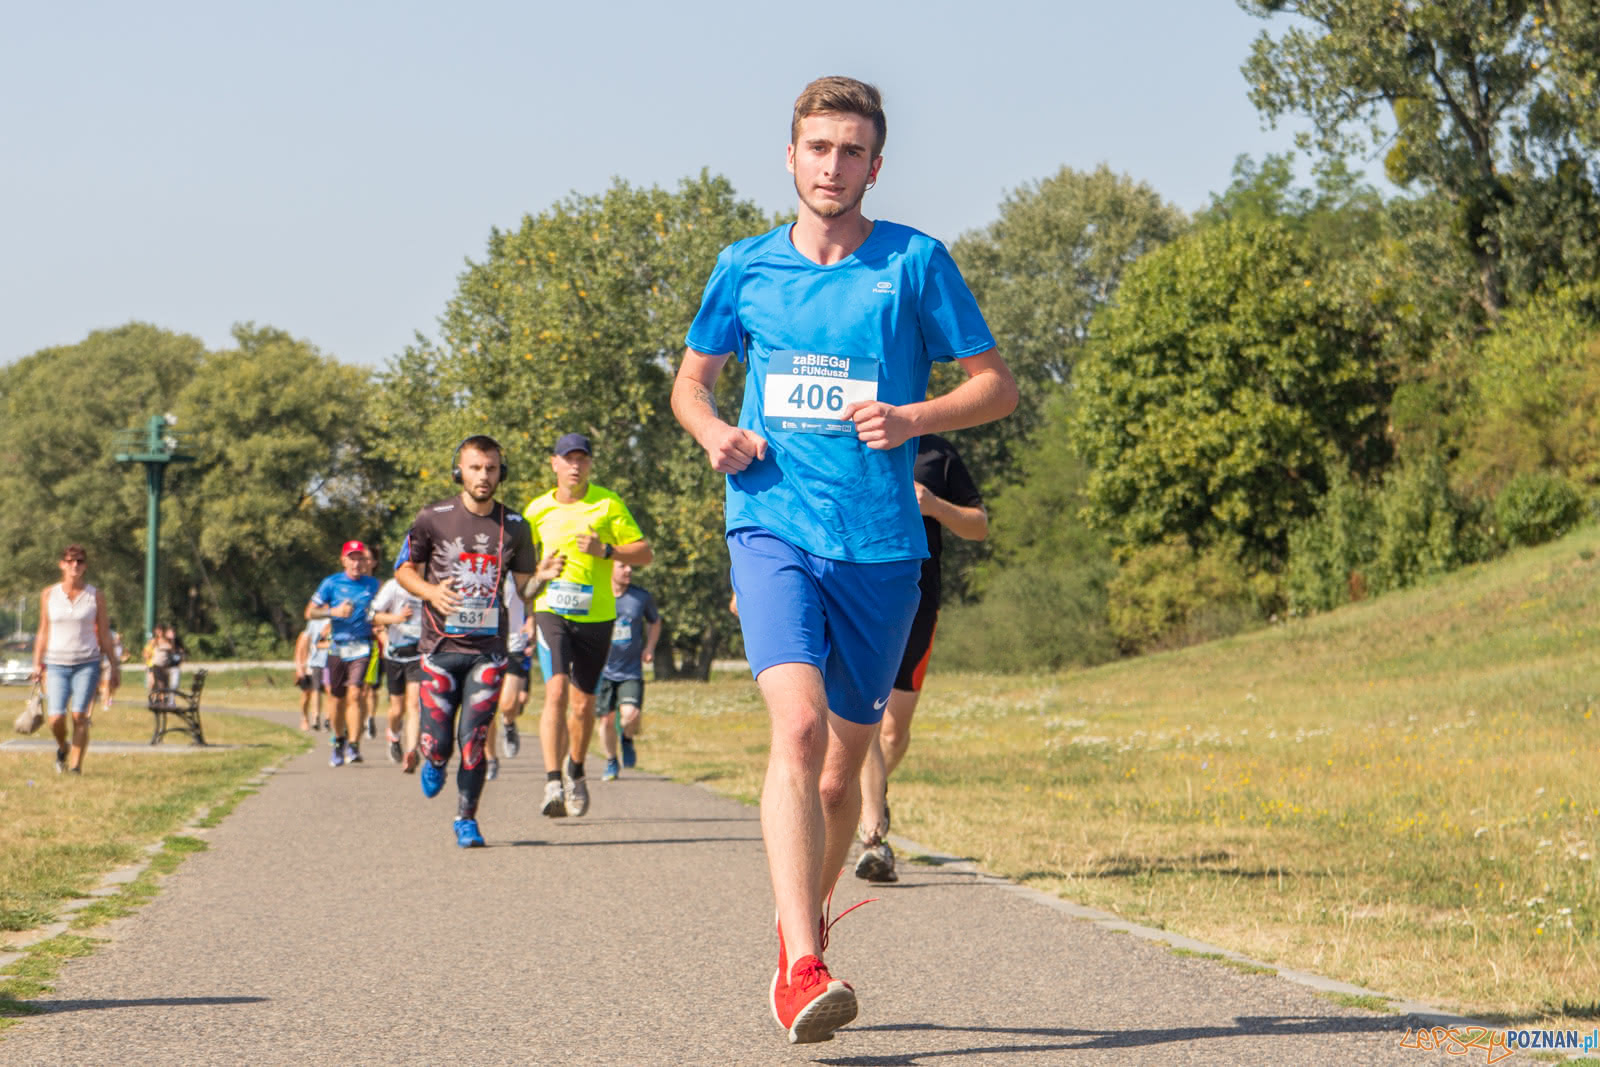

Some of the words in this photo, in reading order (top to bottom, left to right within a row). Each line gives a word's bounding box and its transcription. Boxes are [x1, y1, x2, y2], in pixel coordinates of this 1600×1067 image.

[792, 354, 850, 371] zaBIEGaj
[788, 383, 844, 411] 406
[459, 611, 484, 624] 631
